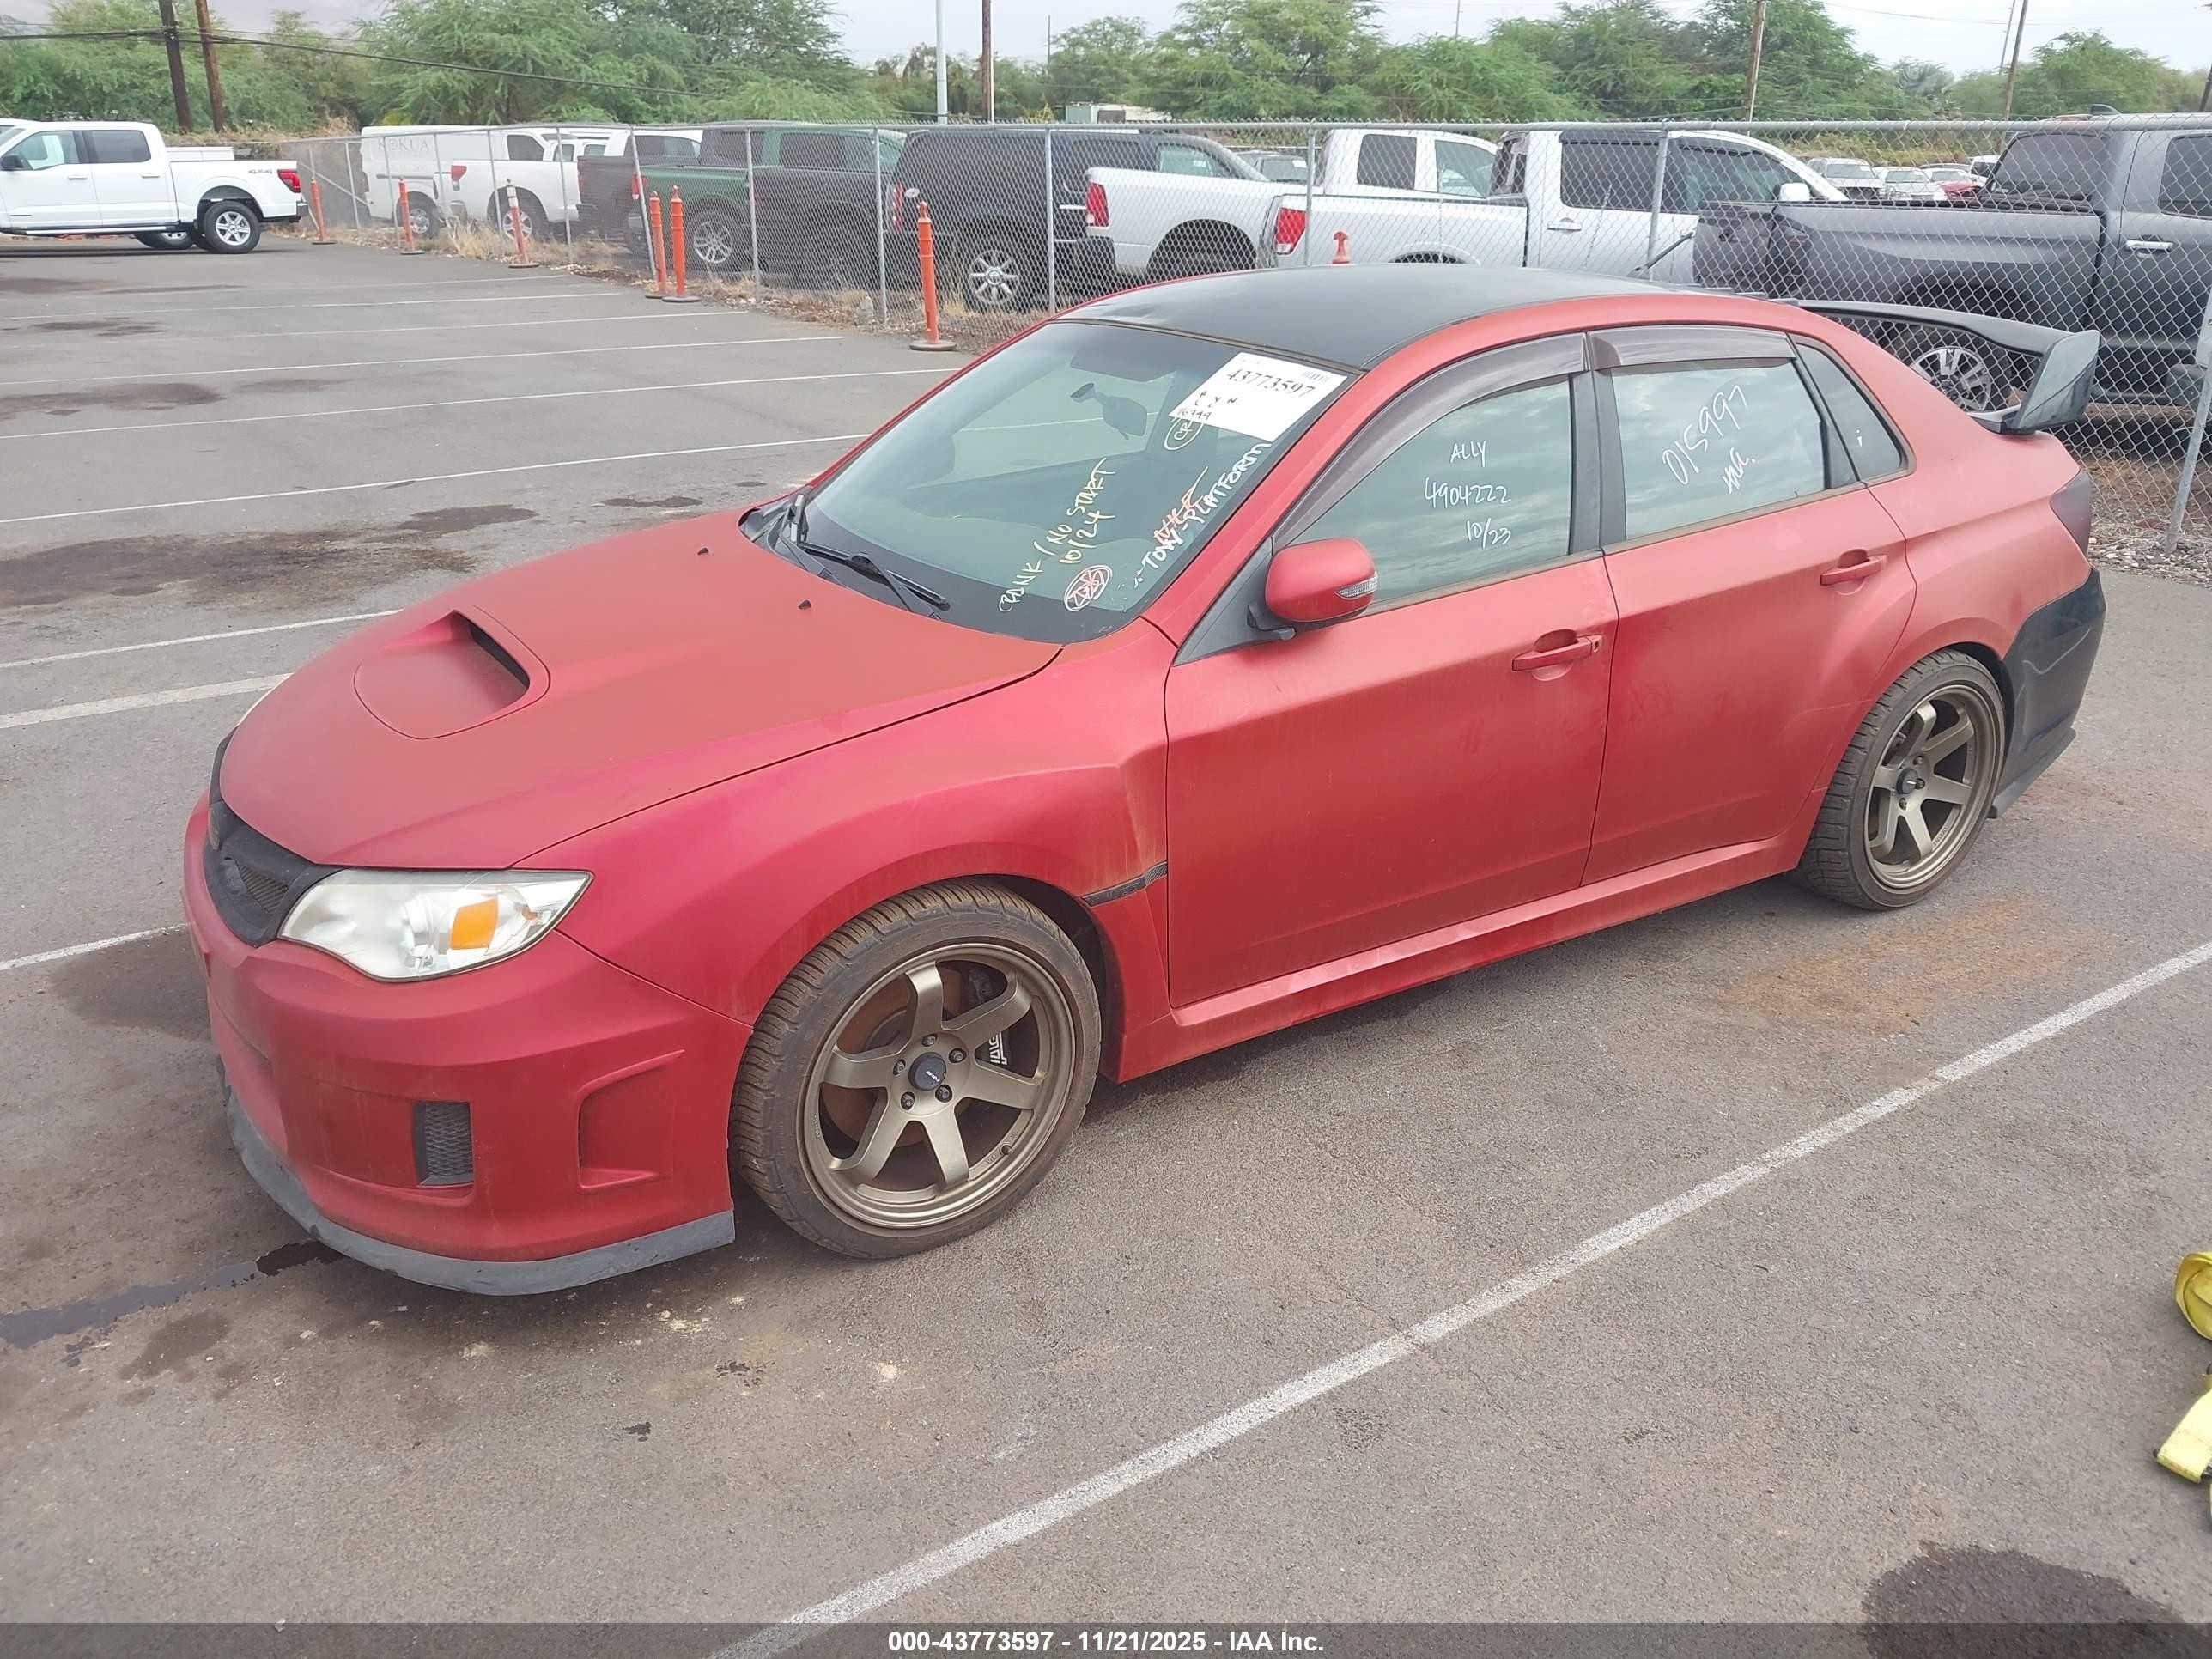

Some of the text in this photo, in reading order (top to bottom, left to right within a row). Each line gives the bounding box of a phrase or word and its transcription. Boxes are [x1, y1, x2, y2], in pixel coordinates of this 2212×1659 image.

[1226, 368, 1316, 398] 43773597
[1662, 385, 1748, 485] 015997
[1450, 441, 1486, 468] ALLY
[1425, 477, 1511, 509] 4904222
[1059, 510, 1116, 564] 10/24
[1467, 518, 1511, 549] 10/23
